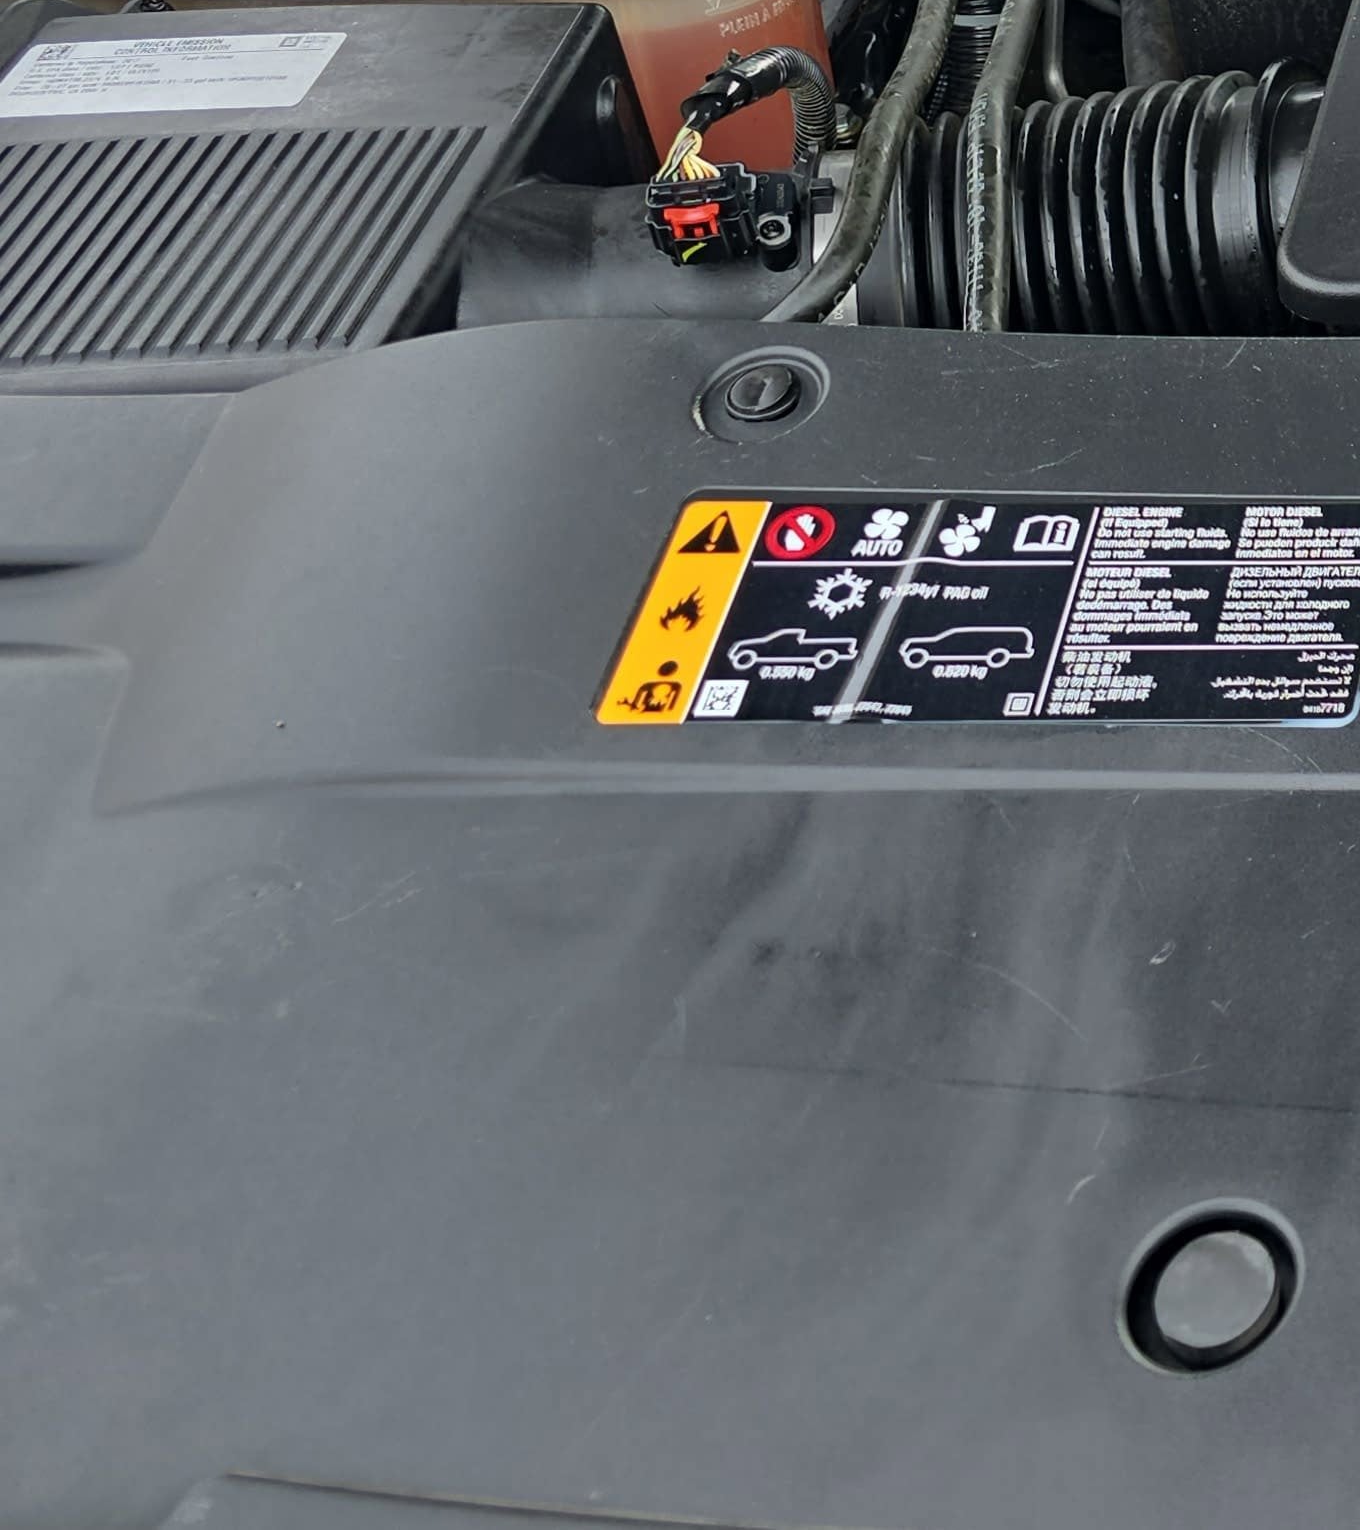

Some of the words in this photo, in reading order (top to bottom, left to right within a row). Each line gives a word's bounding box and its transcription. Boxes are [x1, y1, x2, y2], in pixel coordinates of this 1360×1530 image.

[134, 39, 173, 48] VEHICLE
[176, 37, 224, 46] EMISSION
[114, 46, 160, 55] CONTROL
[162, 44, 232, 53] INFORMATION
[1103, 506, 1140, 517] DIESEL
[1142, 506, 1184, 517] ENGINE
[1245, 506, 1284, 517] MOTOR
[1286, 506, 1323, 517] DIESEL
[1115, 518, 1168, 529] Equipped)
[1273, 518, 1304, 528] tiene)
[1097, 528, 1112, 538] Do
[1114, 529, 1132, 538] not
[1133, 530, 1152, 538] use
[1154, 528, 1195, 539] starting
[1196, 528, 1227, 538] fluids.
[1240, 528, 1255, 538] No
[1257, 529, 1277, 538] use
[1278, 527, 1313, 537] fluidos
[1315, 528, 1329, 537] de
[851, 539, 904, 557] AUTO
[1094, 538, 1149, 549] Immediate
[1151, 539, 1187, 550] engine
[1188, 539, 1231, 550] damage
[1238, 538, 1252, 548] Se
[1254, 538, 1293, 548] pueden
[1294, 538, 1338, 548] producir
[1091, 550, 1111, 559] can
[1113, 549, 1146, 559] result.
[1295, 550, 1308, 558] en
[1310, 548, 1321, 558] el
[1322, 549, 1355, 558] motor.
[1085, 566, 1132, 578] MOTEUR
[1133, 567, 1171, 578] DIESEL
[1230, 566, 1301, 578] ДИЗЕЛЬНЫЙ
[942, 585, 971, 600] PAG
[971, 585, 989, 600] oil
[1079, 589, 1096, 599] Ne
[1096, 591, 1117, 601] pas
[1118, 589, 1155, 599] utiliser
[1157, 589, 1171, 599] de
[1151, 600, 1173, 610] Des
[1072, 611, 1132, 622] dommages
[1069, 624, 1085, 633] au
[1086, 622, 1126, 632] moteur
[1126, 622, 1182, 634] pourraient
[1183, 623, 1198, 632] en
[1061, 651, 1131, 663] 柴油发动机
[797, 665, 816, 682] kg
[970, 664, 988, 680] kg
[1051, 688, 1150, 702] 否则会立即损坏
